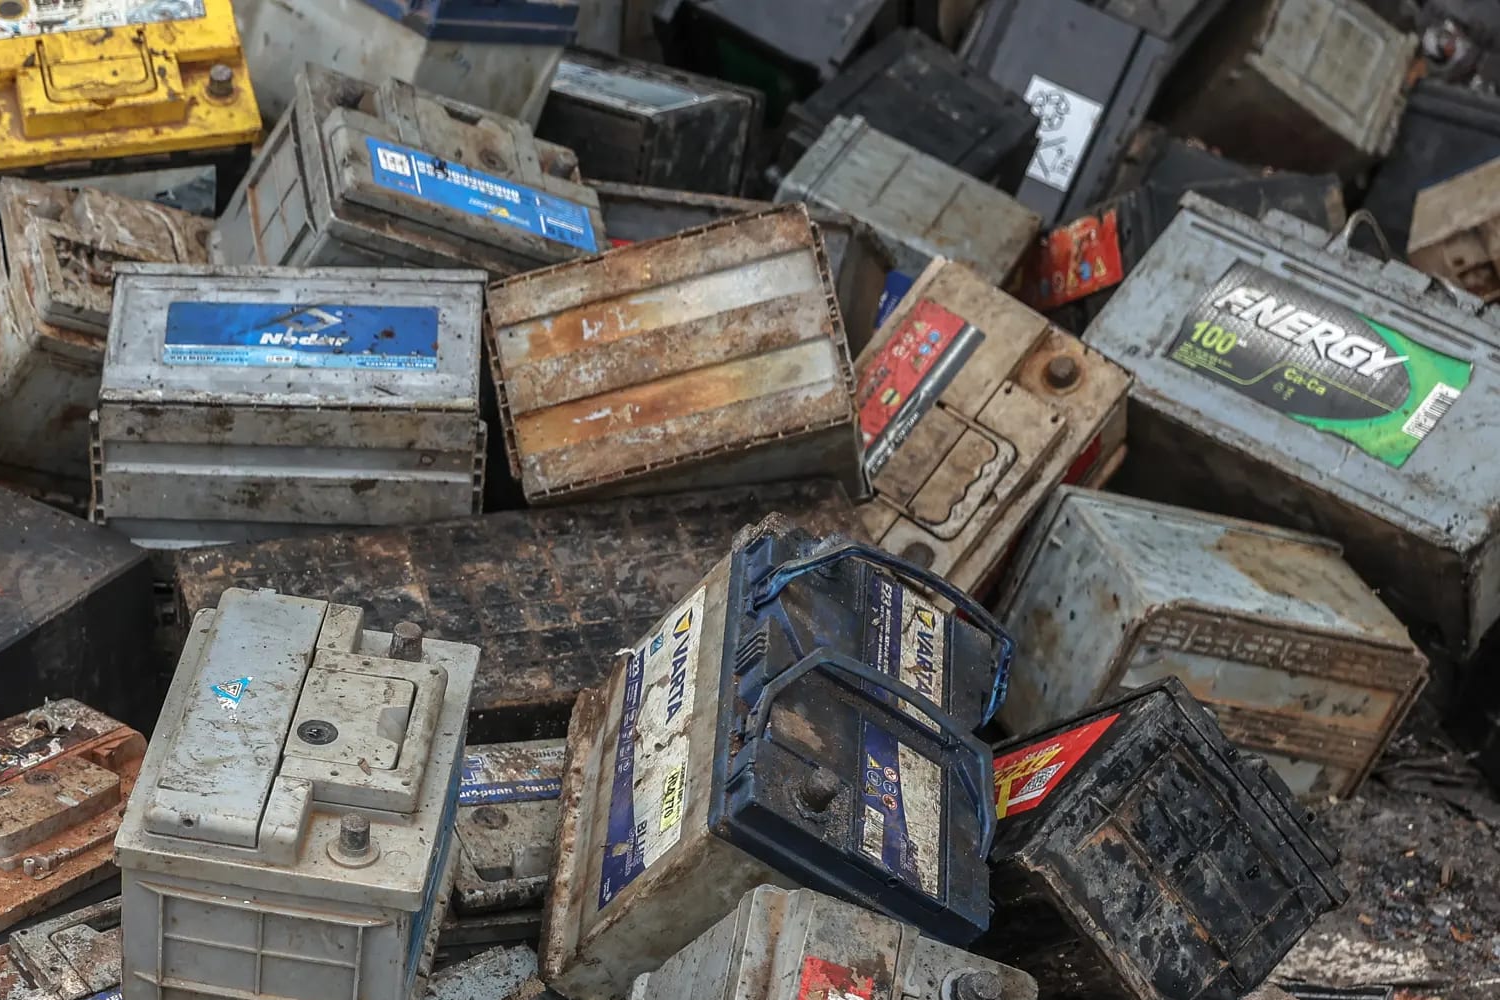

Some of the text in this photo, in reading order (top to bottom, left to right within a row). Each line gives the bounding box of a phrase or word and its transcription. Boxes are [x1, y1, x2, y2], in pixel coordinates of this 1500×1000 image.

[1187, 316, 1238, 358] 100
[1213, 279, 1410, 379] ENERGY
[1281, 364, 1329, 398] Ca-Ca
[915, 624, 933, 694] VARTA
[665, 637, 689, 725] VARTA
[459, 787, 512, 798] uropean
[662, 798, 674, 818] 770
